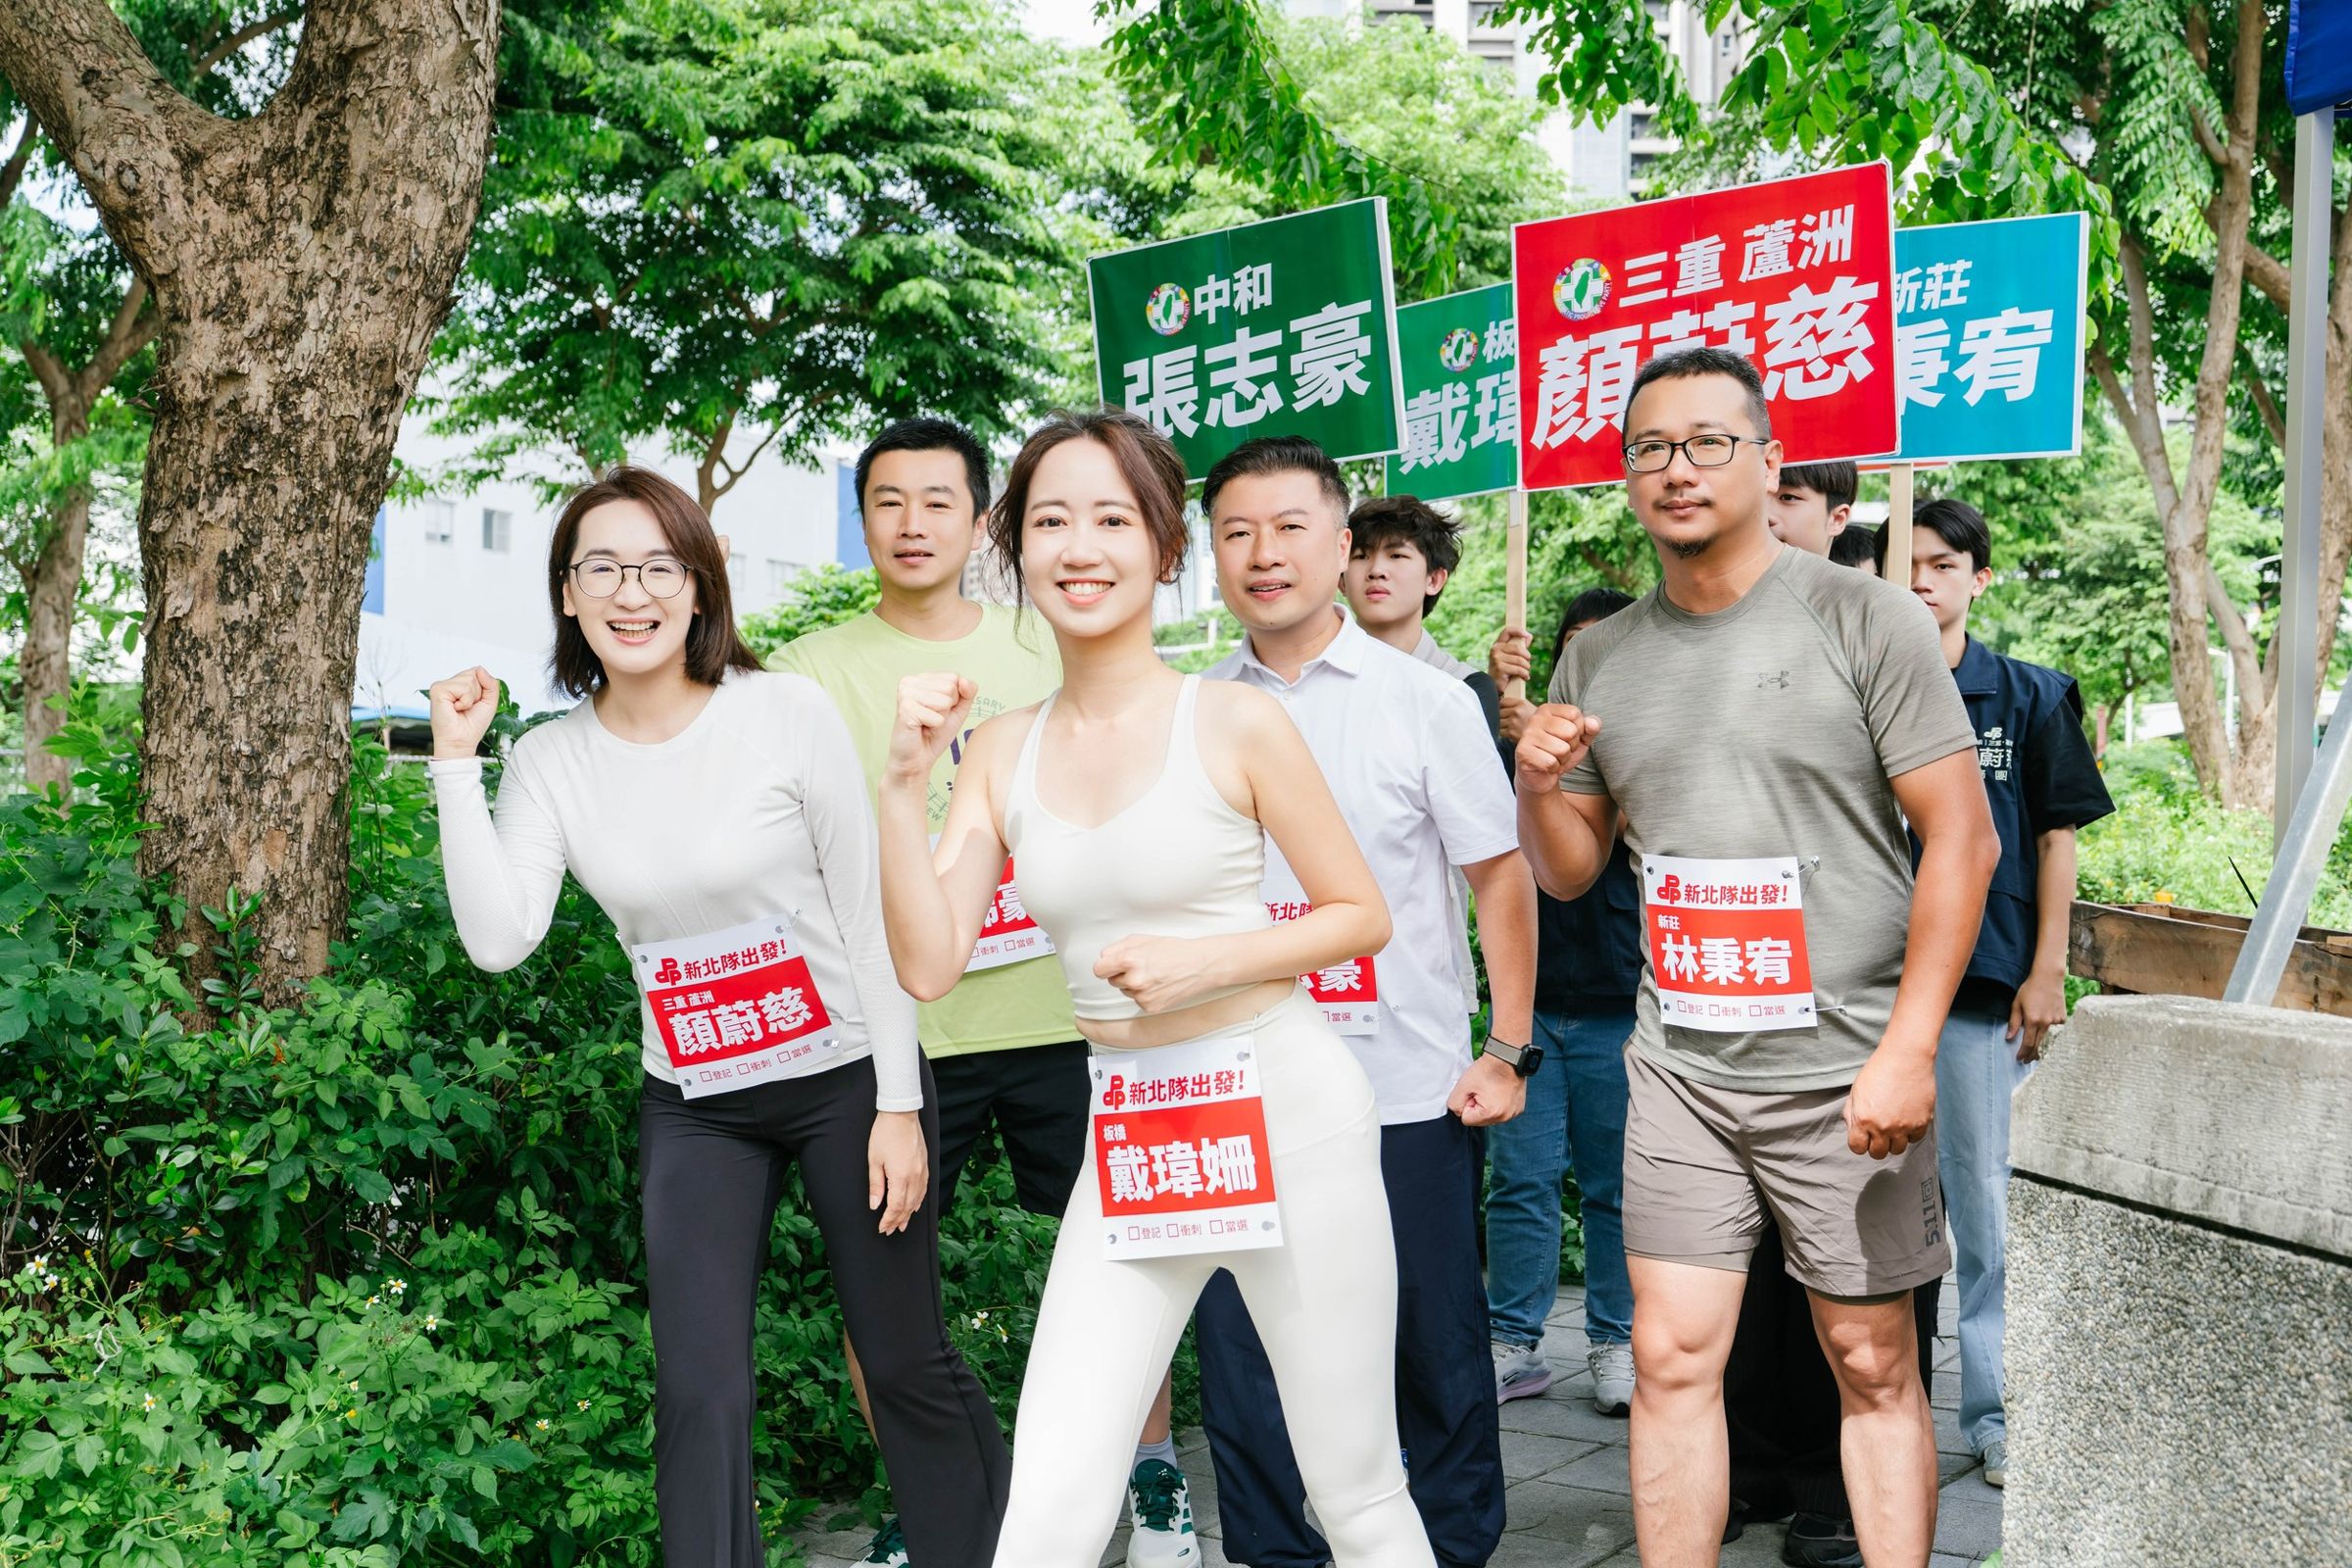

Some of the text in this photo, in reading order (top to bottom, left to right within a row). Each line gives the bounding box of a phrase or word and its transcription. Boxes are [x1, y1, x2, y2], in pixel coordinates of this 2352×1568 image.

[1619, 204, 1855, 310] 三重 蘆洲
[1194, 262, 1273, 324] 中和
[1123, 299, 1372, 440] 張志豪
[1684, 883, 1788, 905] 新北隊出發!
[1657, 914, 1681, 930] 新莊
[683, 939, 788, 981] 新北隊出發!
[1661, 933, 1792, 986] 林秉宥
[662, 994, 688, 1011] 三重
[668, 986, 814, 1056] 顏蔚慈
[1129, 1069, 1245, 1104] 新北隊出發!
[1103, 1123, 1127, 1142] 板橋
[1106, 1134, 1257, 1203] 戴瑋姍
